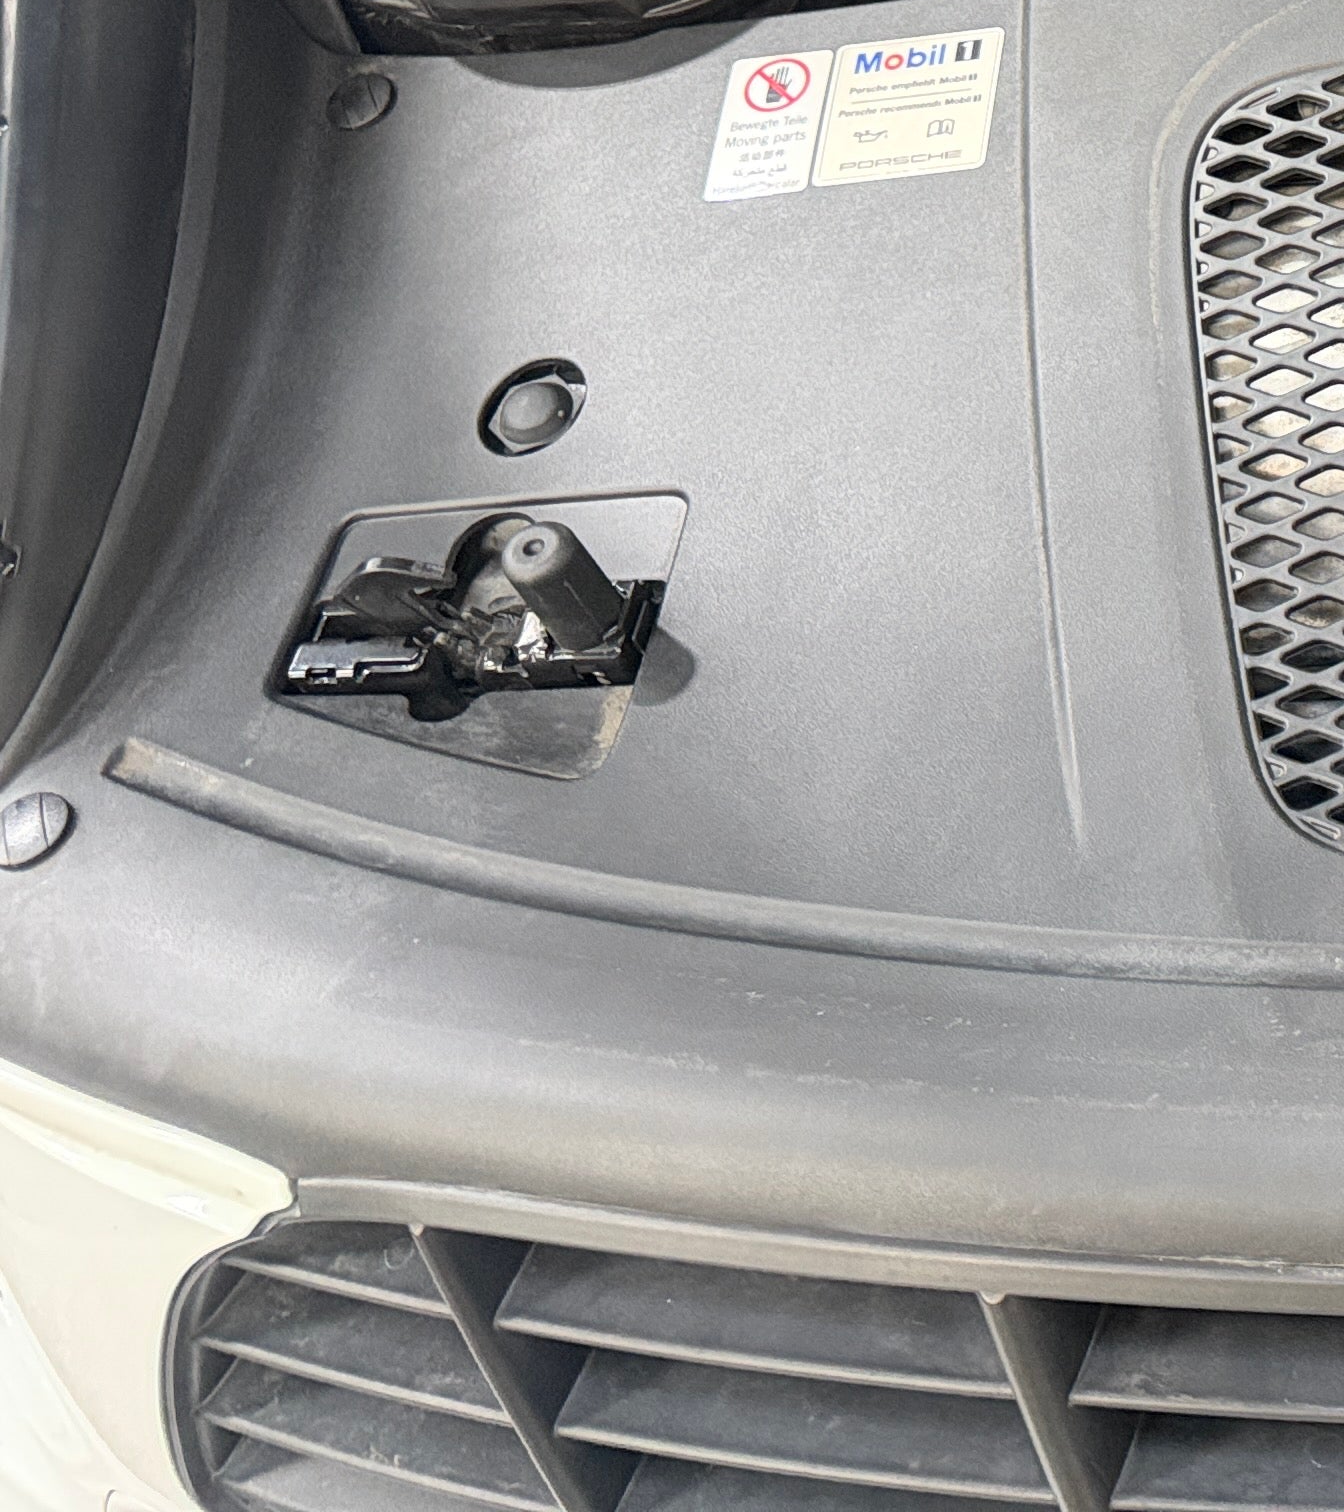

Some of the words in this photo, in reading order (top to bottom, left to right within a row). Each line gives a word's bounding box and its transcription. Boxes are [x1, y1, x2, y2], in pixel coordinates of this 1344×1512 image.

[854, 43, 947, 74] Mobil
[957, 40, 981, 61] 1
[849, 83, 889, 94] Porsche
[939, 75, 967, 85] Mobil
[838, 107, 877, 118] Porsche
[944, 96, 971, 105] Mobil
[730, 118, 780, 132] Bewegte
[725, 135, 770, 149] Moving
[773, 130, 807, 145] parts
[839, 149, 962, 171] PORSCHE
